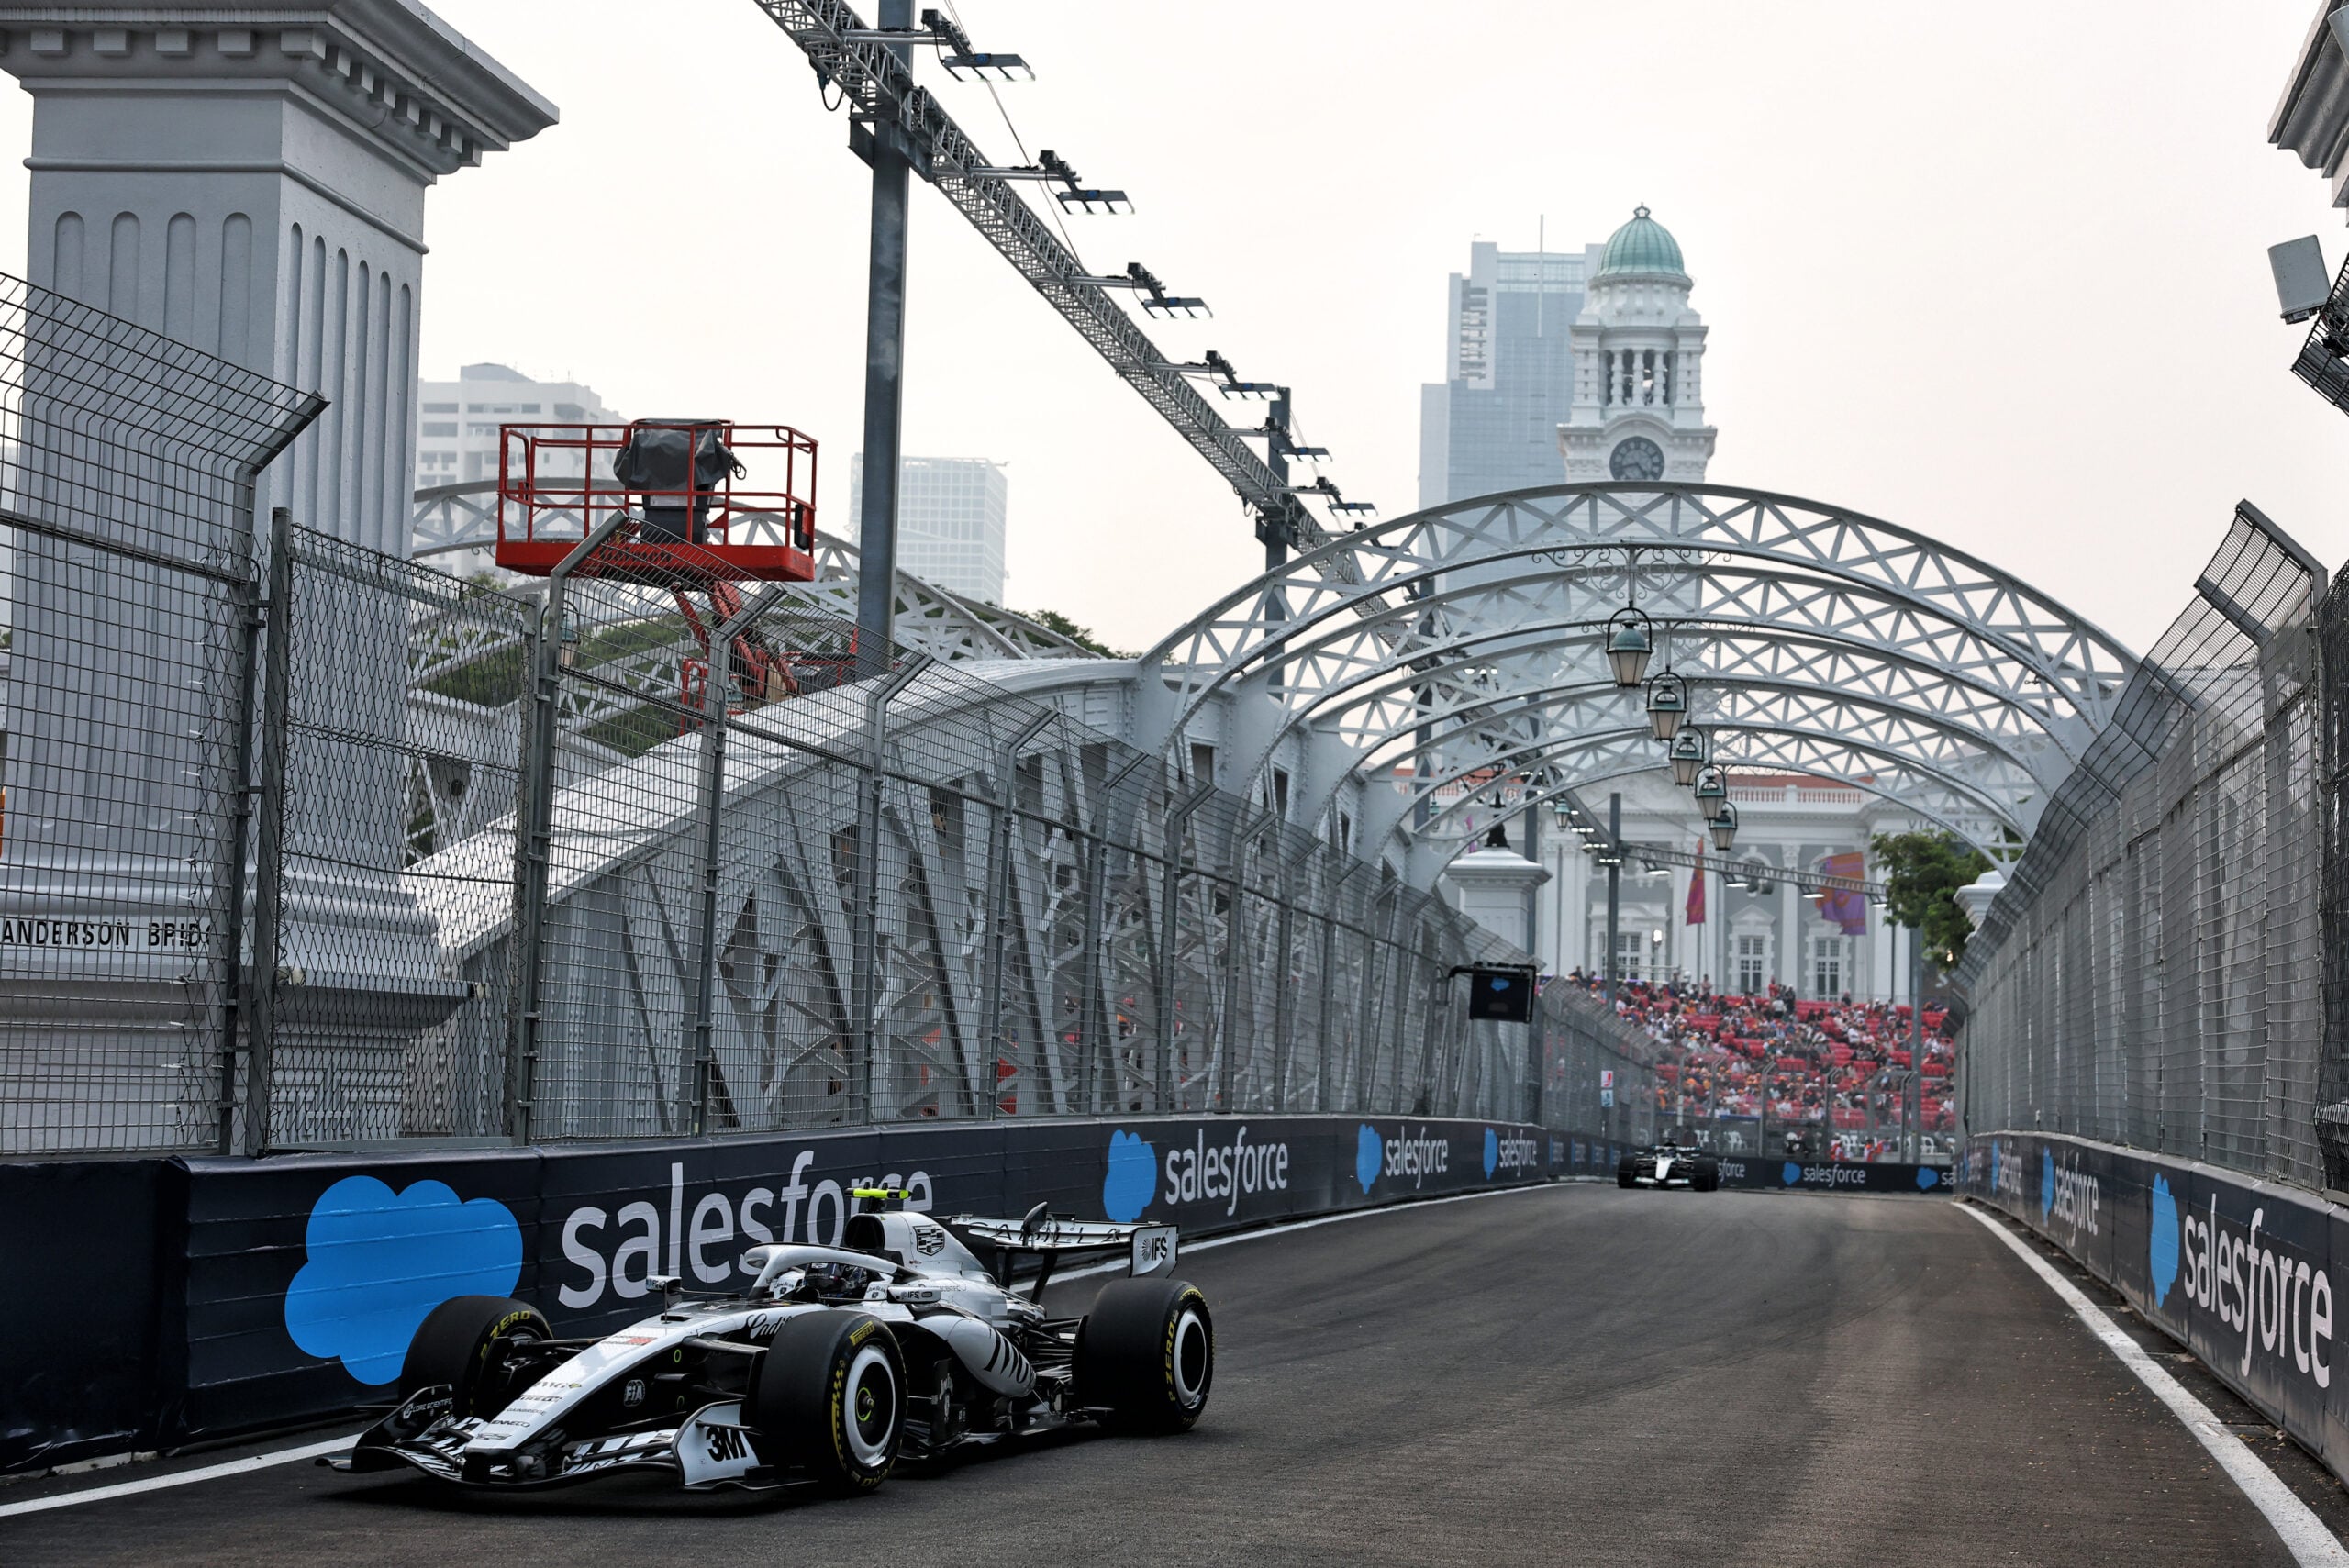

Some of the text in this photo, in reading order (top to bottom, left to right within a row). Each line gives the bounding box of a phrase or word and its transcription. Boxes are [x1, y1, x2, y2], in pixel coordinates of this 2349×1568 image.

[3, 920, 211, 947] ANDERSON BRID
[1385, 1125, 1448, 1189] salesforce
[1499, 1129, 1538, 1177] salesforce
[1165, 1126, 1288, 1217] salesforce
[1803, 1163, 1866, 1188] salesforce
[2054, 1150, 2099, 1247] salesforce
[1151, 1236, 1168, 1261] IFS
[907, 1291, 920, 1299] IFS
[2184, 1193, 2332, 1388] salesforce
[849, 1320, 876, 1346] PIRELLI
[1164, 1320, 1175, 1385] ZERO
[413, 1404, 427, 1413] CORE
[706, 1427, 747, 1462] 3M
